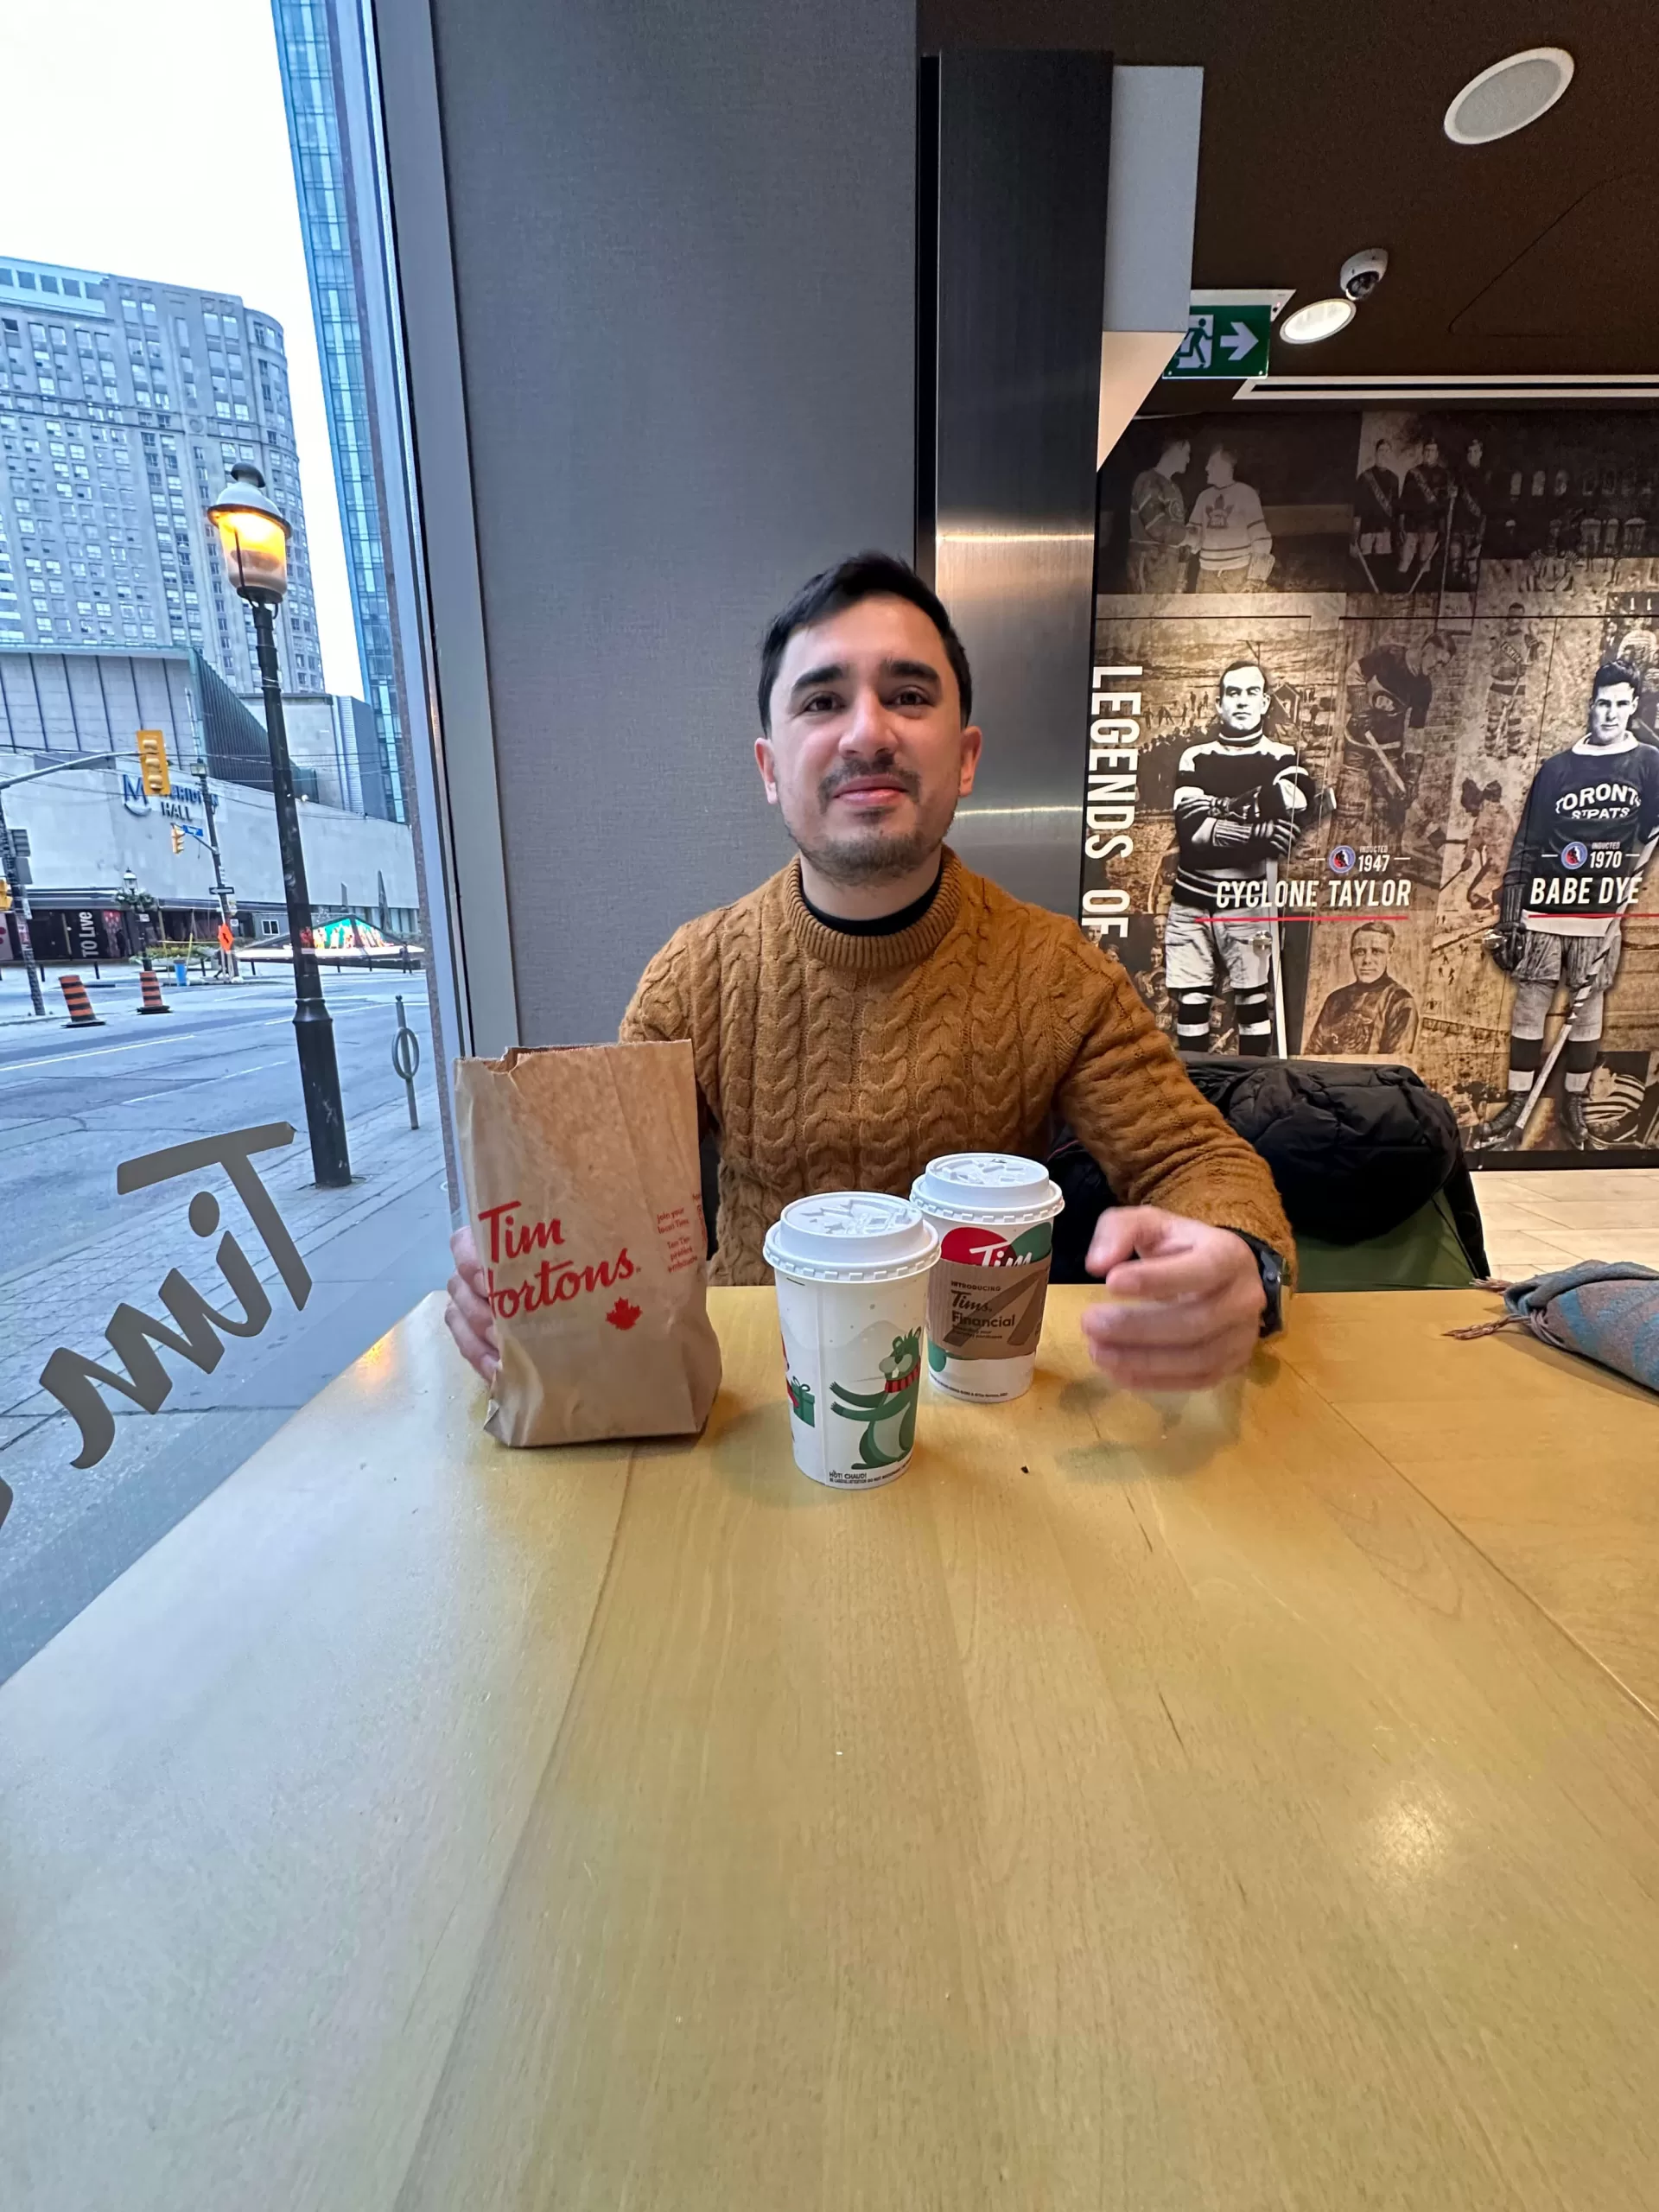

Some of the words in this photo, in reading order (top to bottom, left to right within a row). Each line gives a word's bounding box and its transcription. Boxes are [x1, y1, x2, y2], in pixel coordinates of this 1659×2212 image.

[1084, 666, 1143, 859] LEGENDS
[161, 801, 193, 822] HALL
[1357, 854, 1390, 873] 1947
[1589, 850, 1623, 869] 1970
[1216, 880, 1320, 908] CYCLONE
[1328, 879, 1412, 907] TAYLOR
[1529, 877, 1593, 905] BABE
[1598, 876, 1643, 905] DYE
[1081, 889, 1131, 938] OF
[478, 1200, 566, 1264] Tim
[950, 1280, 1002, 1292] INTRODUCING
[951, 1310, 1015, 1328] Financial
